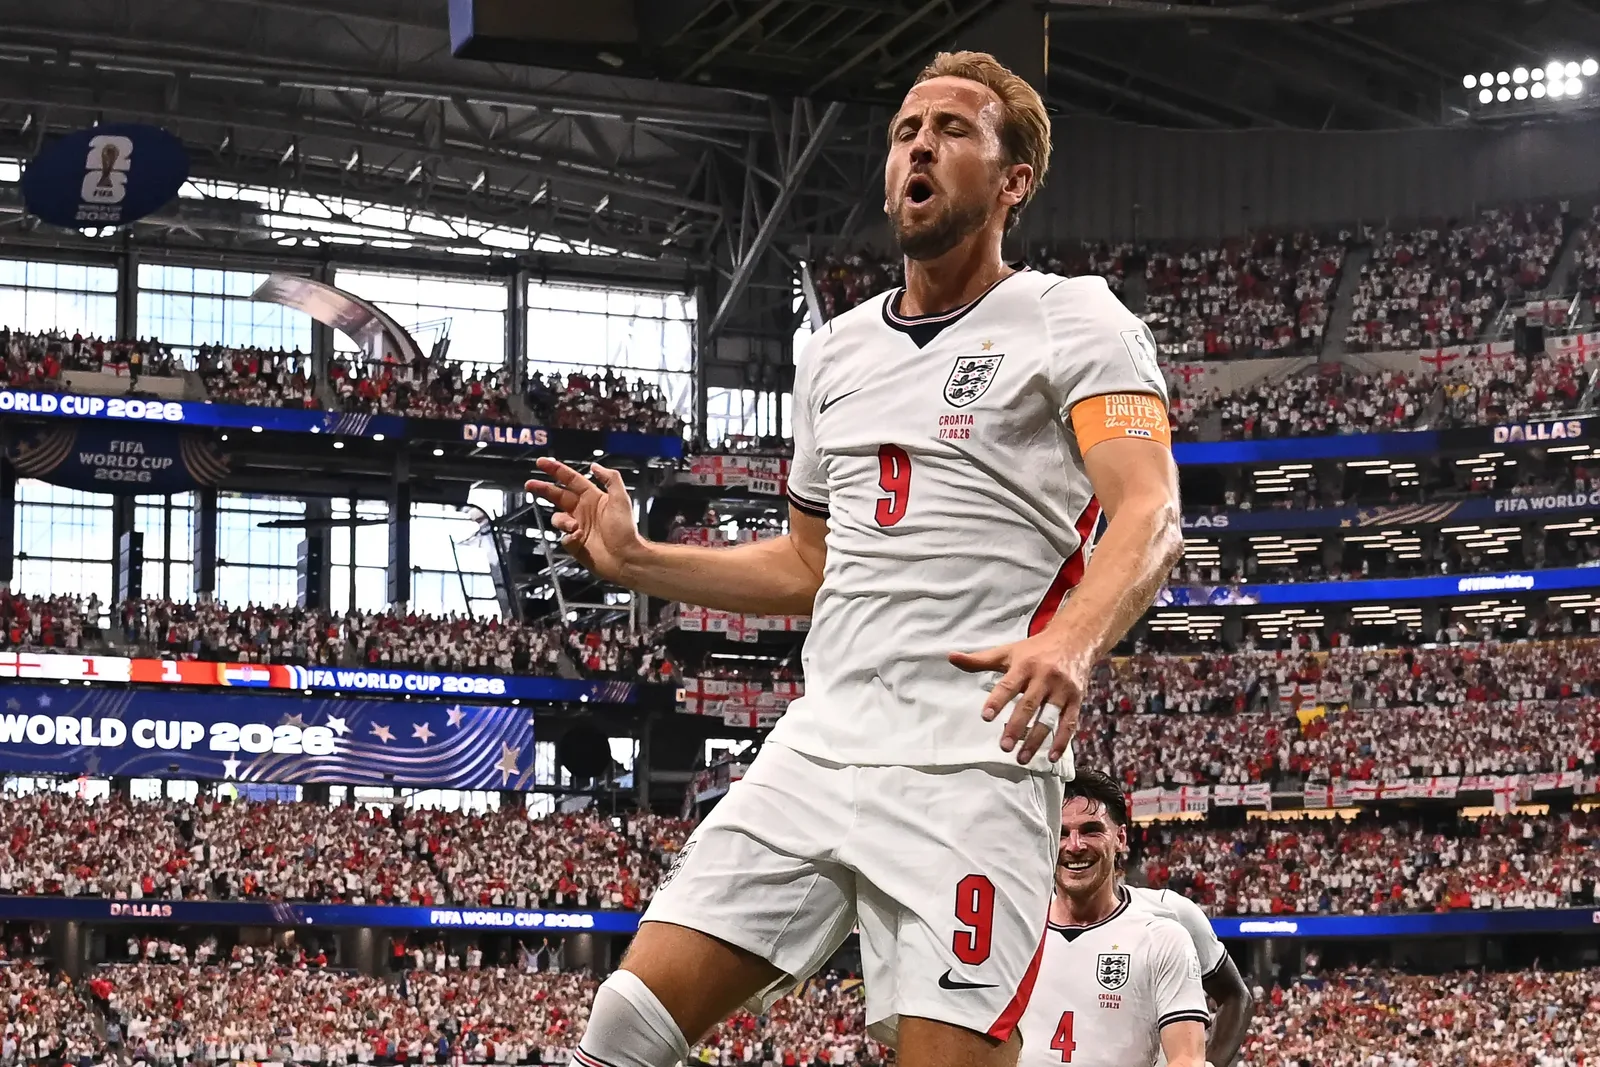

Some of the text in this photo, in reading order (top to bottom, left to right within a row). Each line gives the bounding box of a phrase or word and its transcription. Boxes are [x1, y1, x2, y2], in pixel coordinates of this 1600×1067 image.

[0, 391, 184, 421] ORLD CUP 2026
[1105, 395, 1159, 410] FOOTBALL
[938, 414, 974, 426] CROATIA
[1105, 404, 1163, 422] UNITES
[938, 428, 971, 440] 17.06.26
[1104, 416, 1167, 434] the World
[1127, 429, 1151, 437] FIFA
[1493, 420, 1582, 443] DALLAS
[463, 423, 548, 446] DALLAS
[110, 440, 144, 454] FIFA
[79, 453, 173, 470] WORLD CUP
[94, 469, 152, 482] 2026
[873, 443, 912, 527] 9
[1494, 498, 1529, 513] FIFA
[1530, 493, 1587, 510] WORLD
[82, 658, 99, 676] 1
[161, 661, 182, 682] 1
[307, 669, 506, 695] IFA WORLD CUP 2026
[0, 713, 337, 757] WORLD CUP 2026
[110, 903, 173, 917] DALLAS
[430, 910, 594, 929] FIFA WORLD CUP 2026
[952, 873, 996, 967] 9
[1098, 993, 1122, 1002] CROATIA
[1049, 1010, 1077, 1064] 4
